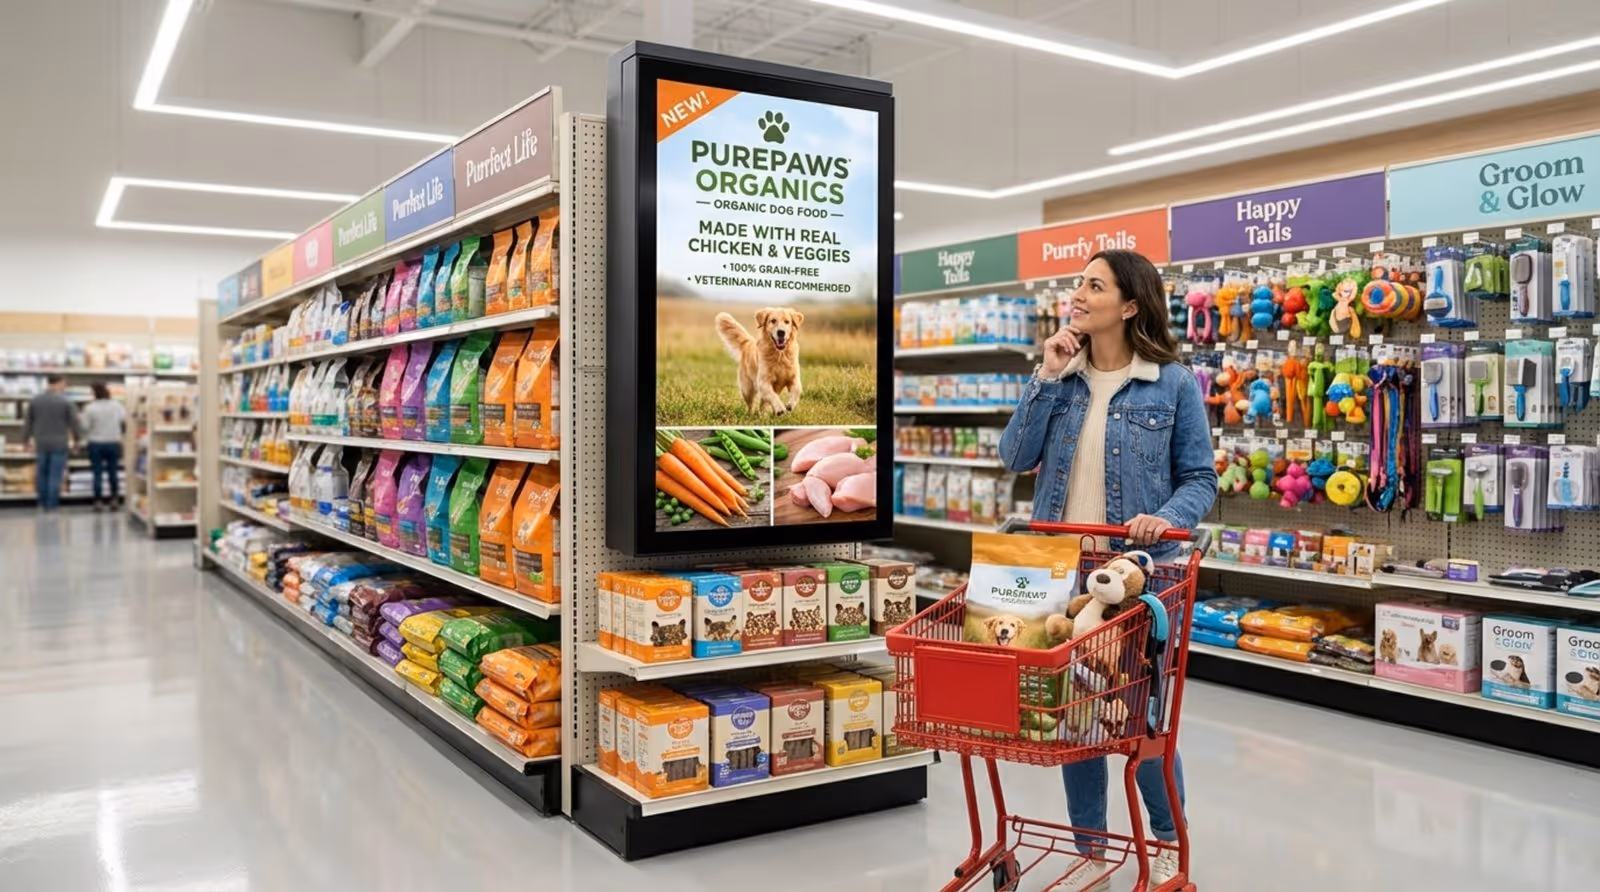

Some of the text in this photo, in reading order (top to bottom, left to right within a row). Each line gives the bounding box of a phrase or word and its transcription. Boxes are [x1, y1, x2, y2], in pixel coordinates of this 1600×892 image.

[660, 90, 710, 128] NEW!
[514, 127, 538, 165] Life
[692, 140, 849, 179] PUREPAWS
[1479, 156, 1585, 187] Groom
[696, 169, 844, 205] ORGANICS
[1479, 182, 1585, 214] & Glow
[713, 199, 828, 219] ORGANIC DOG FOOD
[1236, 197, 1302, 222] Happy
[699, 220, 841, 245] MADE WITH REAL
[1245, 222, 1292, 246] Tails
[688, 238, 850, 263] CHICKEN & VEGGIES
[1042, 236, 1093, 261] Purrfy
[694, 275, 772, 289] VETERINARIAN
[729, 262, 820, 277] 100% GRAIN-FREE
[1493, 625, 1535, 640] Groom
